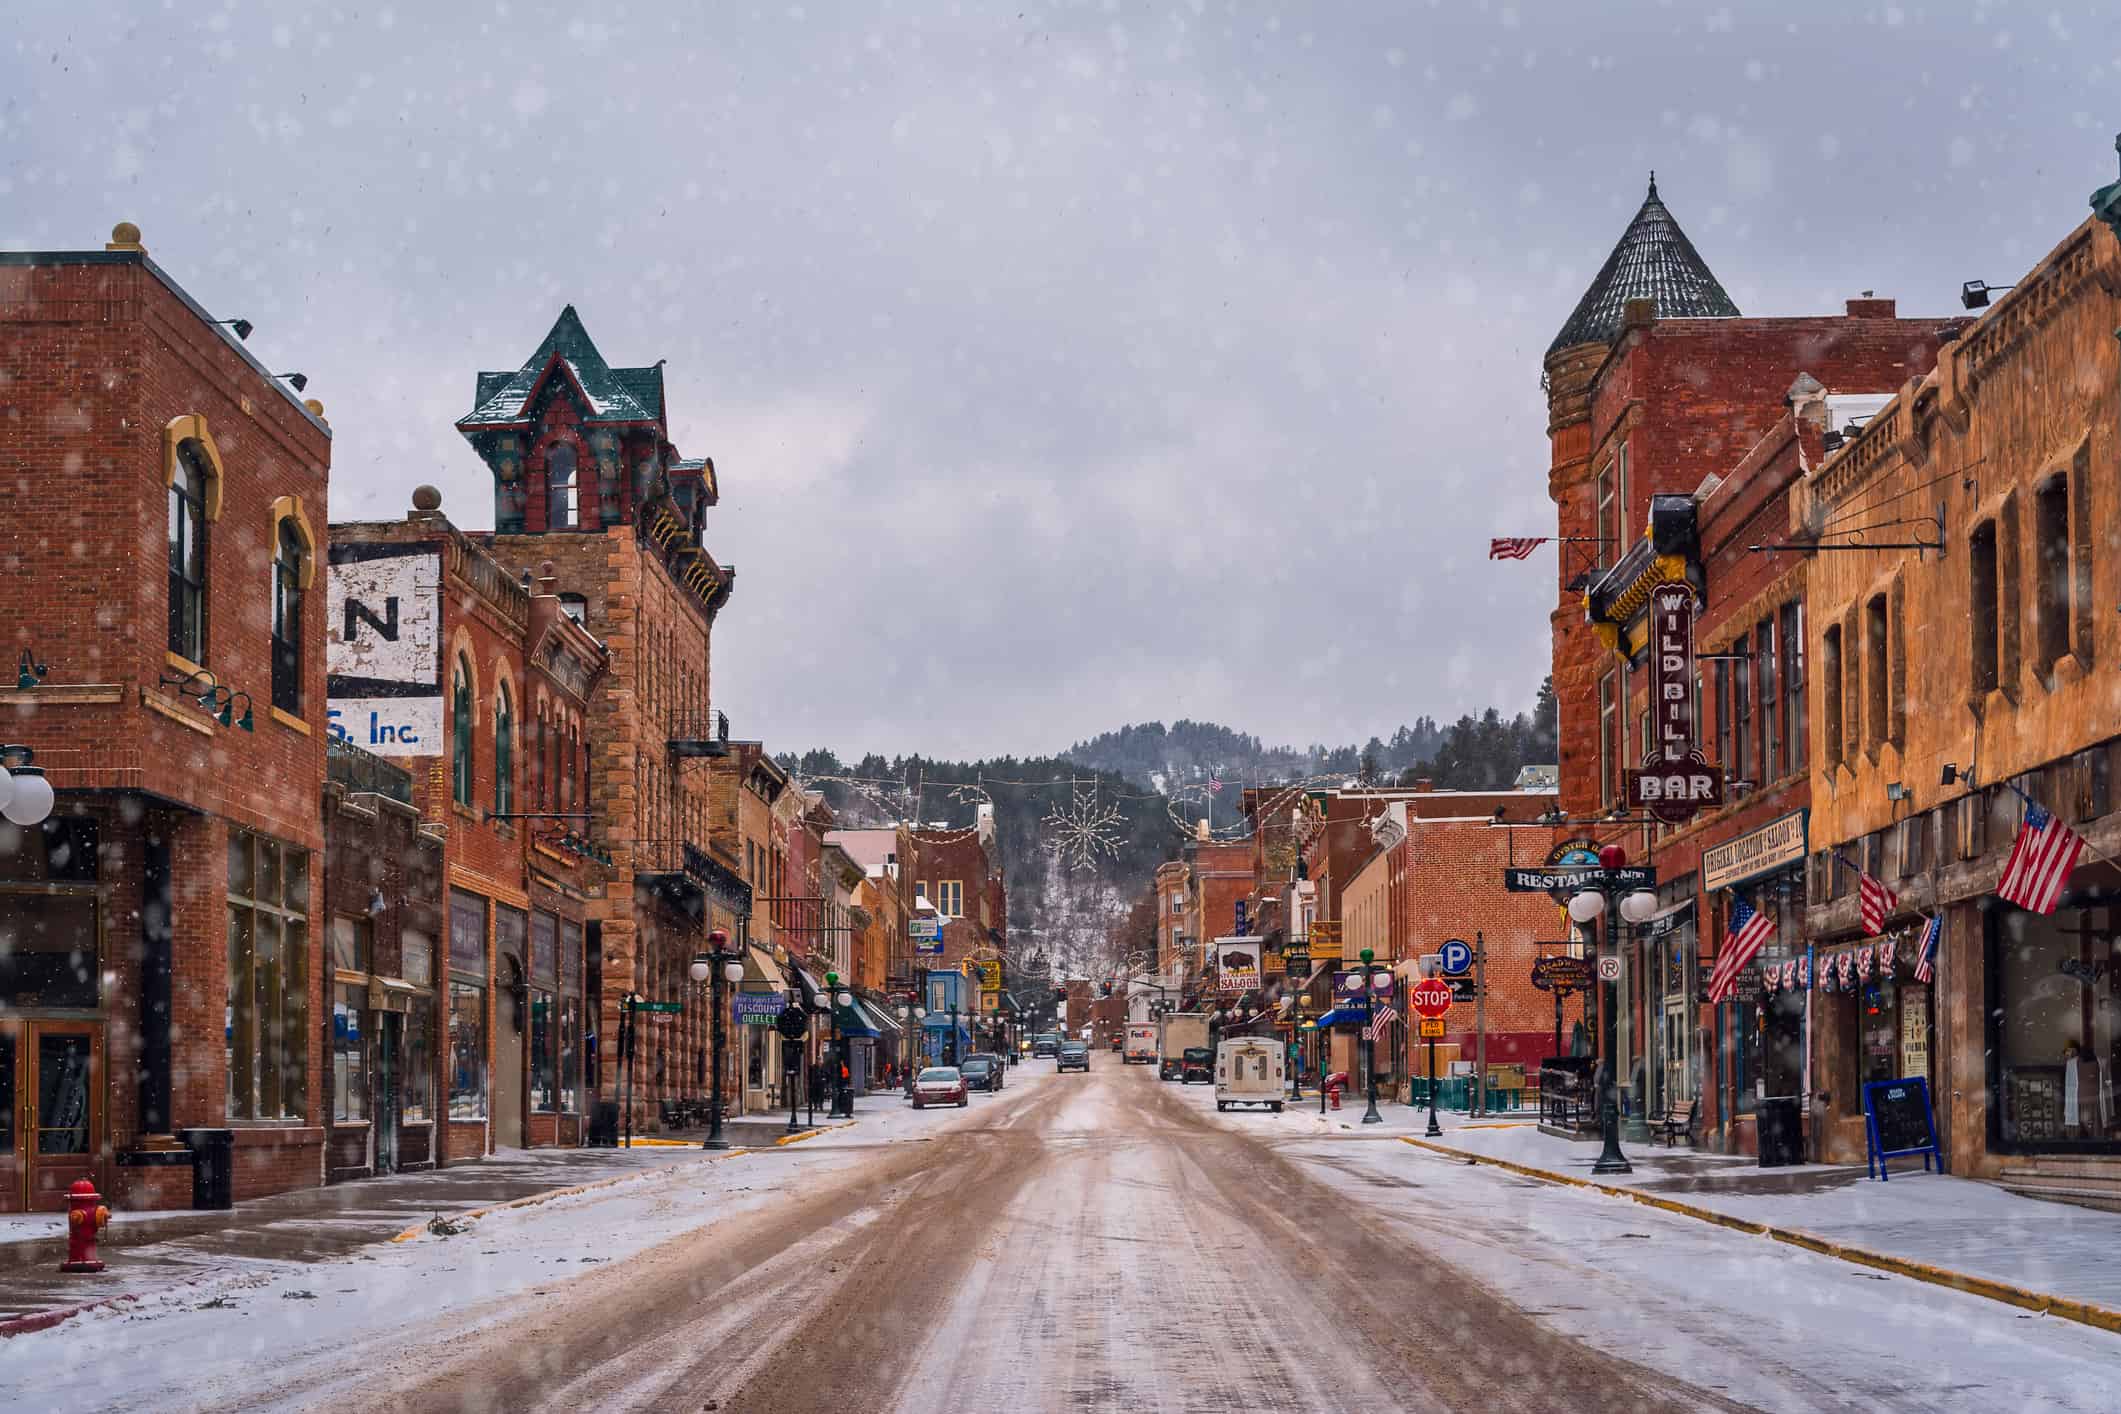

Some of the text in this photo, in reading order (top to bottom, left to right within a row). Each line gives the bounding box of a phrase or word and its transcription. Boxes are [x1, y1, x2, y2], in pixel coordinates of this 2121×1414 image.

[1661, 594, 1685, 761] WILD BILL
[369, 711, 419, 745] Inc.
[1639, 775, 1713, 800] BAR
[1553, 841, 1588, 860] OYSTER
[1705, 846, 1733, 874] ORIGINAL
[1734, 833, 1763, 862] LOCATION
[1767, 821, 1790, 849] SALOON
[1447, 946, 1466, 970] P
[1220, 978, 1260, 990] SALOON
[737, 1003, 782, 1014] DISCOUNT
[1413, 991, 1449, 1006] STOP
[742, 1014, 777, 1024] OUTLET
